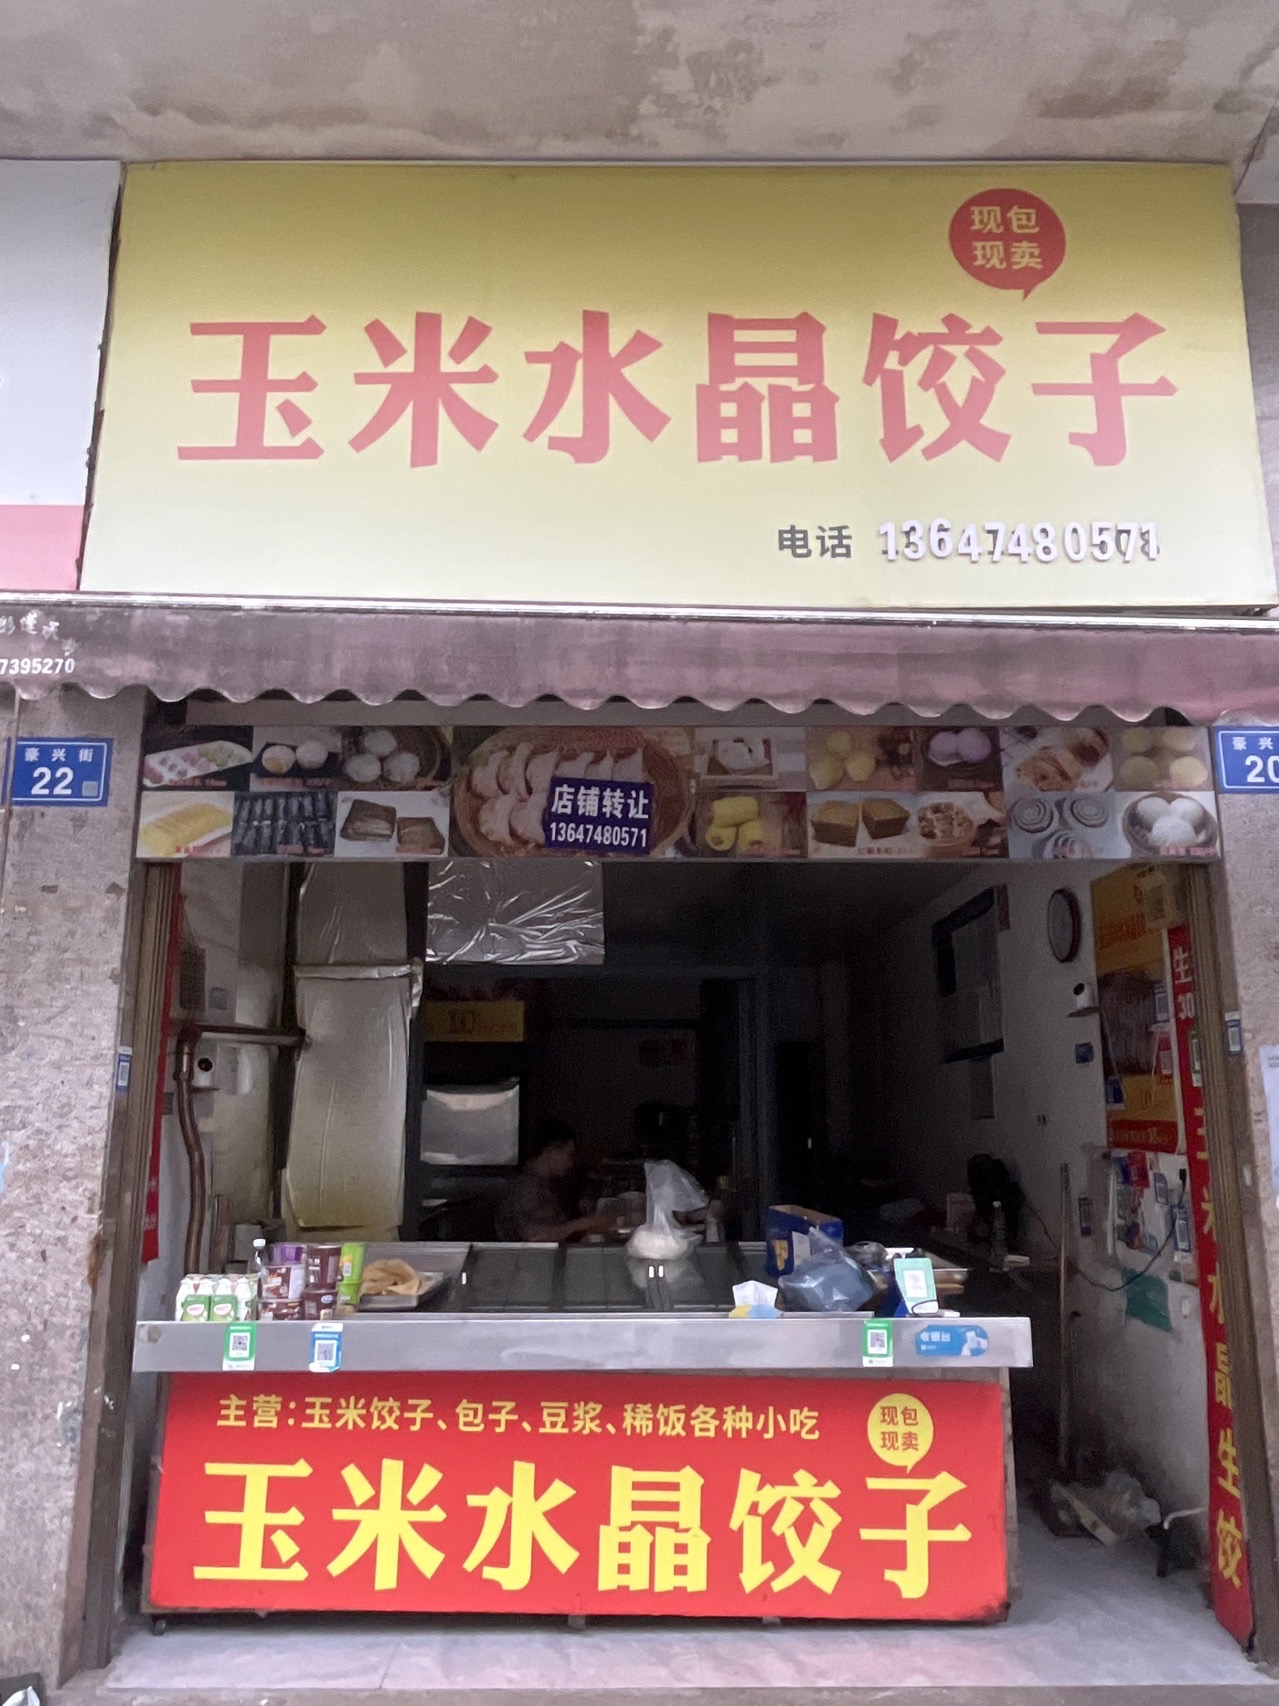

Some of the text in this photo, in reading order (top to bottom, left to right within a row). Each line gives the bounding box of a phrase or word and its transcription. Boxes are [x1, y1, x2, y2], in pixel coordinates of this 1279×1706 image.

[970, 205, 1040, 234] 现包
[972, 240, 1043, 270] 现卖
[178, 310, 1178, 468] 玉米水晶饺子
[778, 517, 1160, 563] 电话 13647480571
[31, 766, 74, 795] 22
[550, 783, 650, 820] 店铺转让
[549, 821, 648, 849] 13647480571
[880, 1406, 919, 1427] 现包
[880, 1431, 919, 1452] 现卖
[193, 1457, 972, 1600] 玉米水晶饺子
